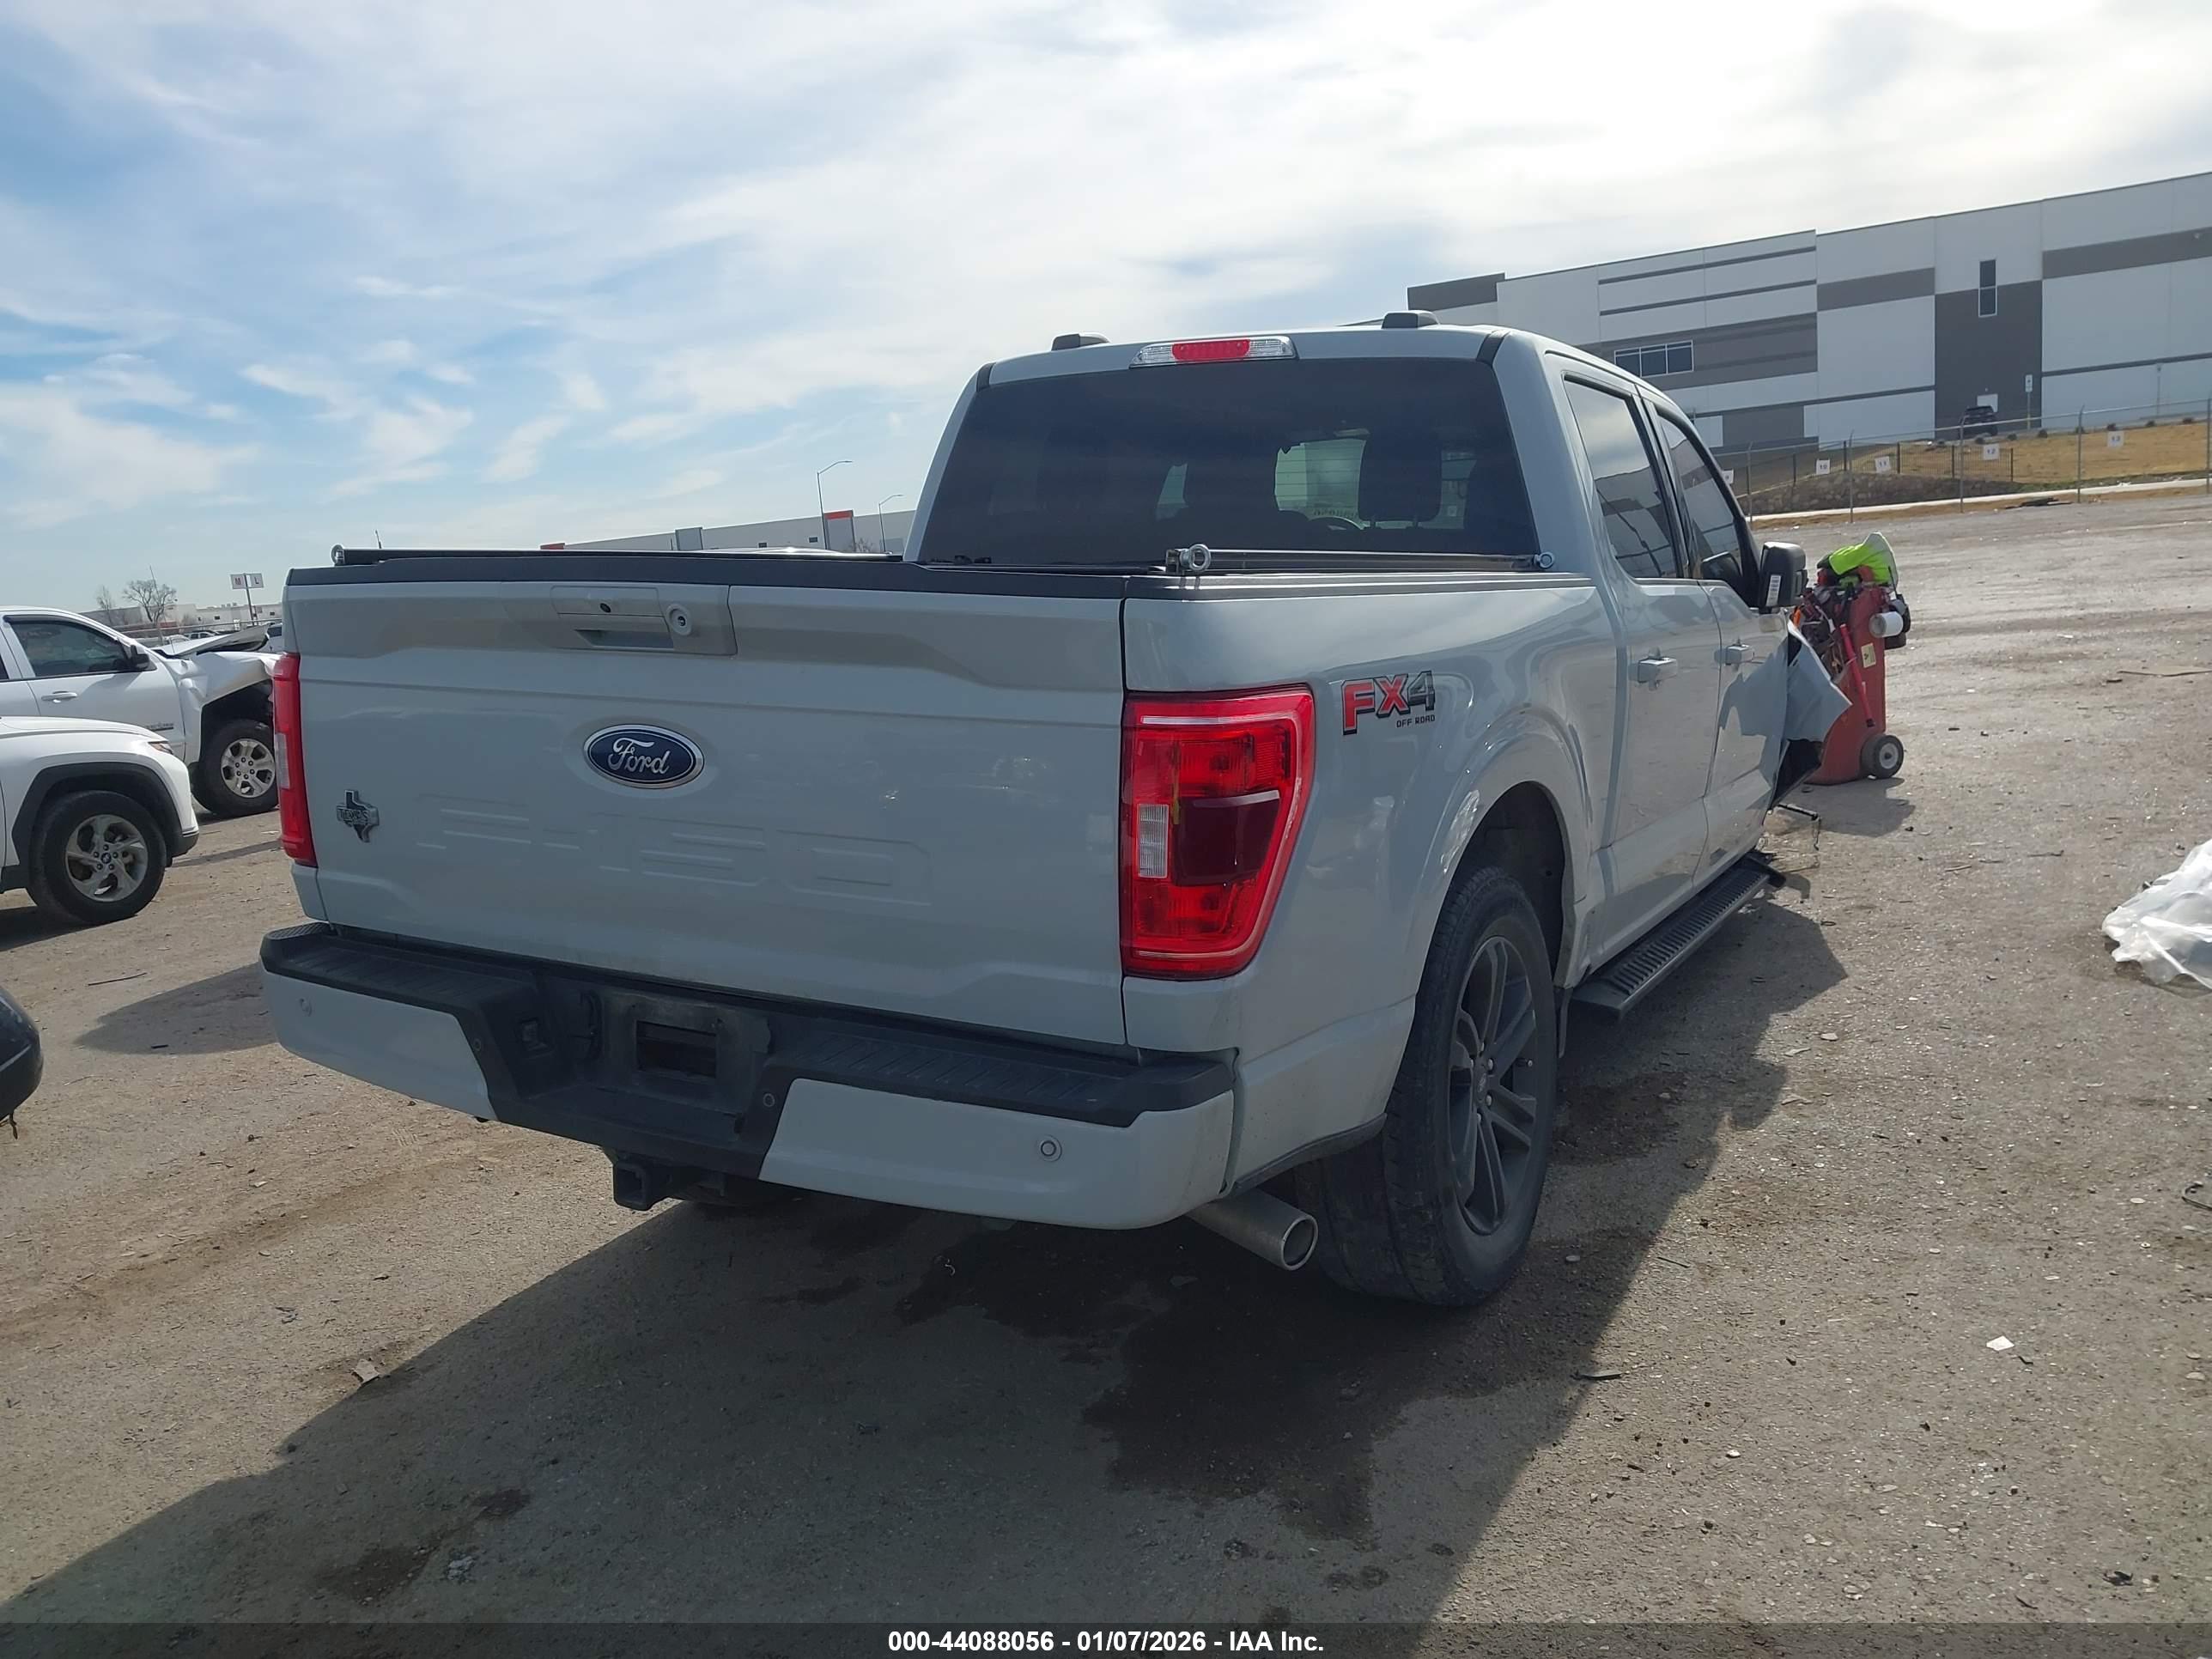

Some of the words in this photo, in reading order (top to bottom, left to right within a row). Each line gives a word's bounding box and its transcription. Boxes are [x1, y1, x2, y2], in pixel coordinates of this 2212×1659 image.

[1340, 670, 1436, 736] FX4
[1396, 719, 1413, 728] OFF
[1415, 714, 1436, 724] ROAD
[607, 737, 671, 775] Ford
